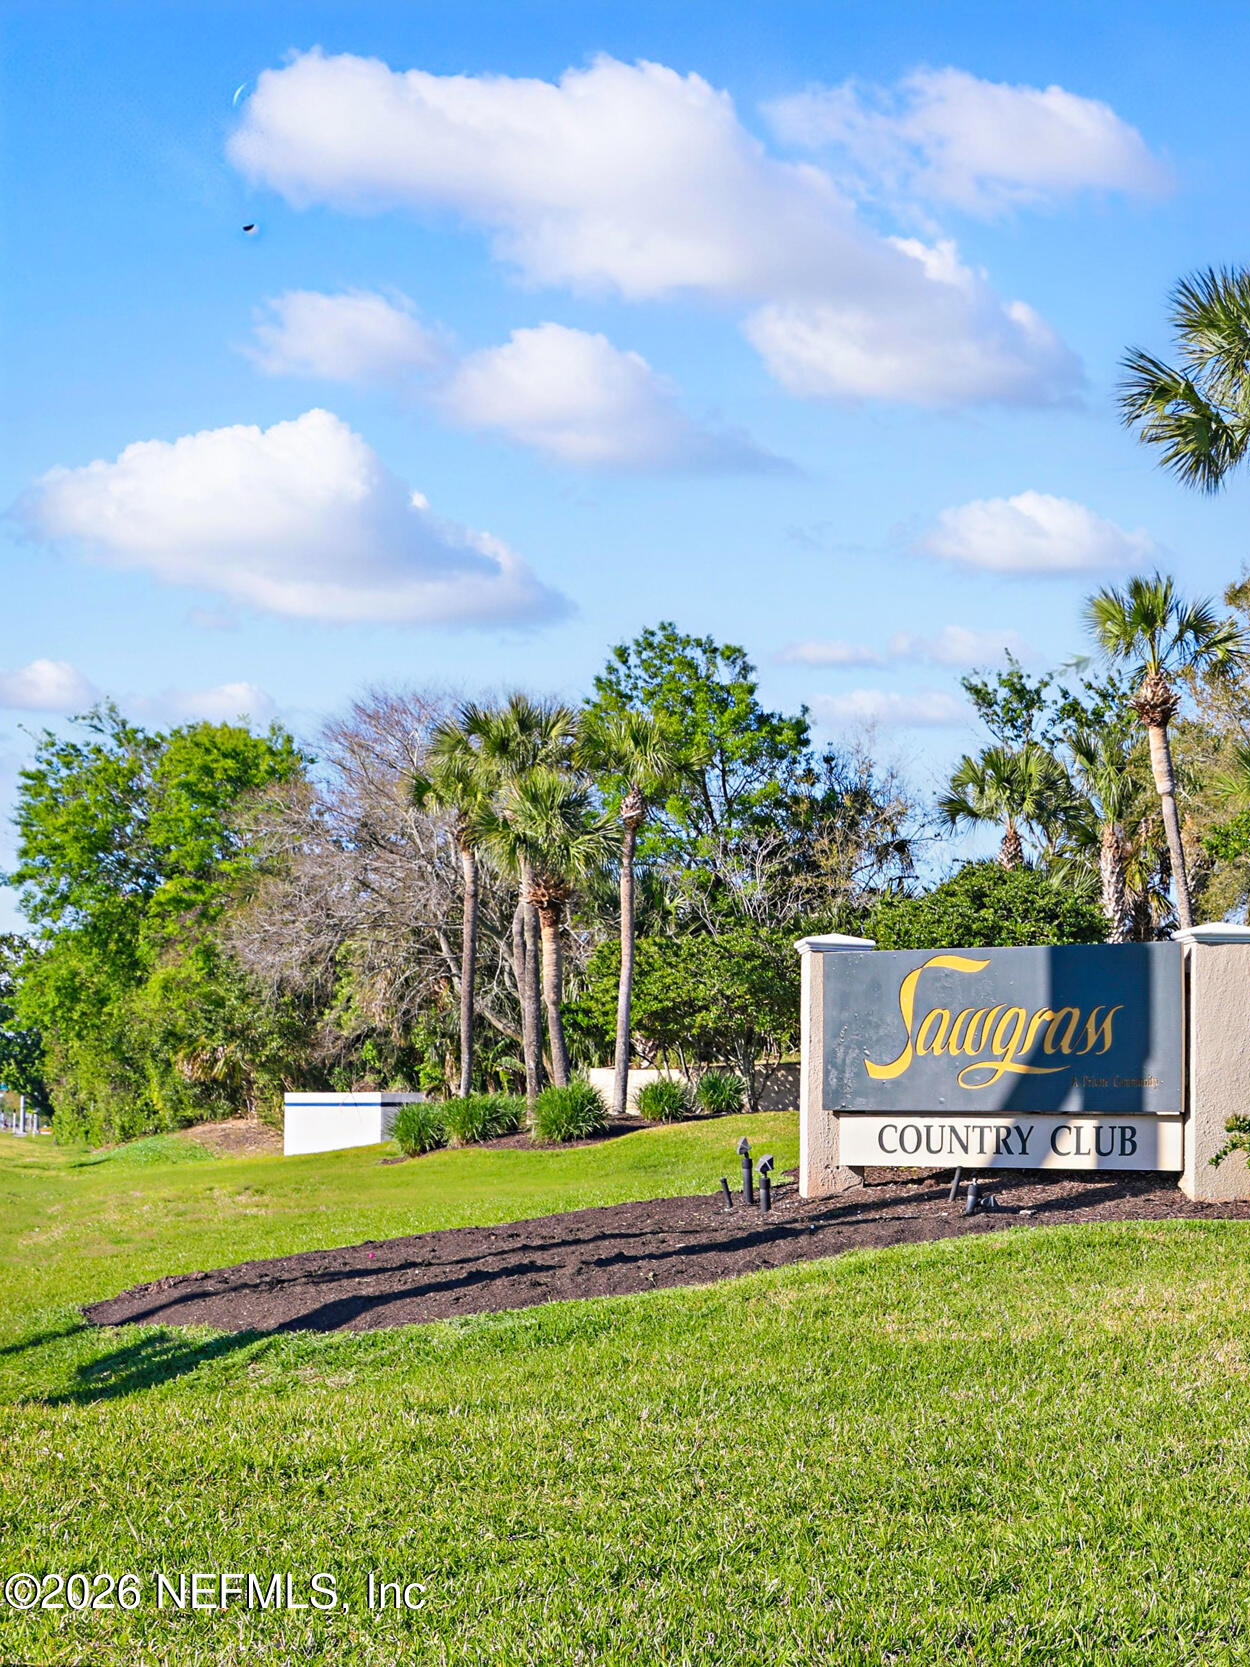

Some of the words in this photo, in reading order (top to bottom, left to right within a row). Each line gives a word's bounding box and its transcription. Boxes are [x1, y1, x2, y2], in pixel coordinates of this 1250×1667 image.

[864, 955, 1125, 1089] Sawgrass
[878, 1124, 1034, 1156] COUNTRY
[1050, 1125, 1138, 1157] CLUB
